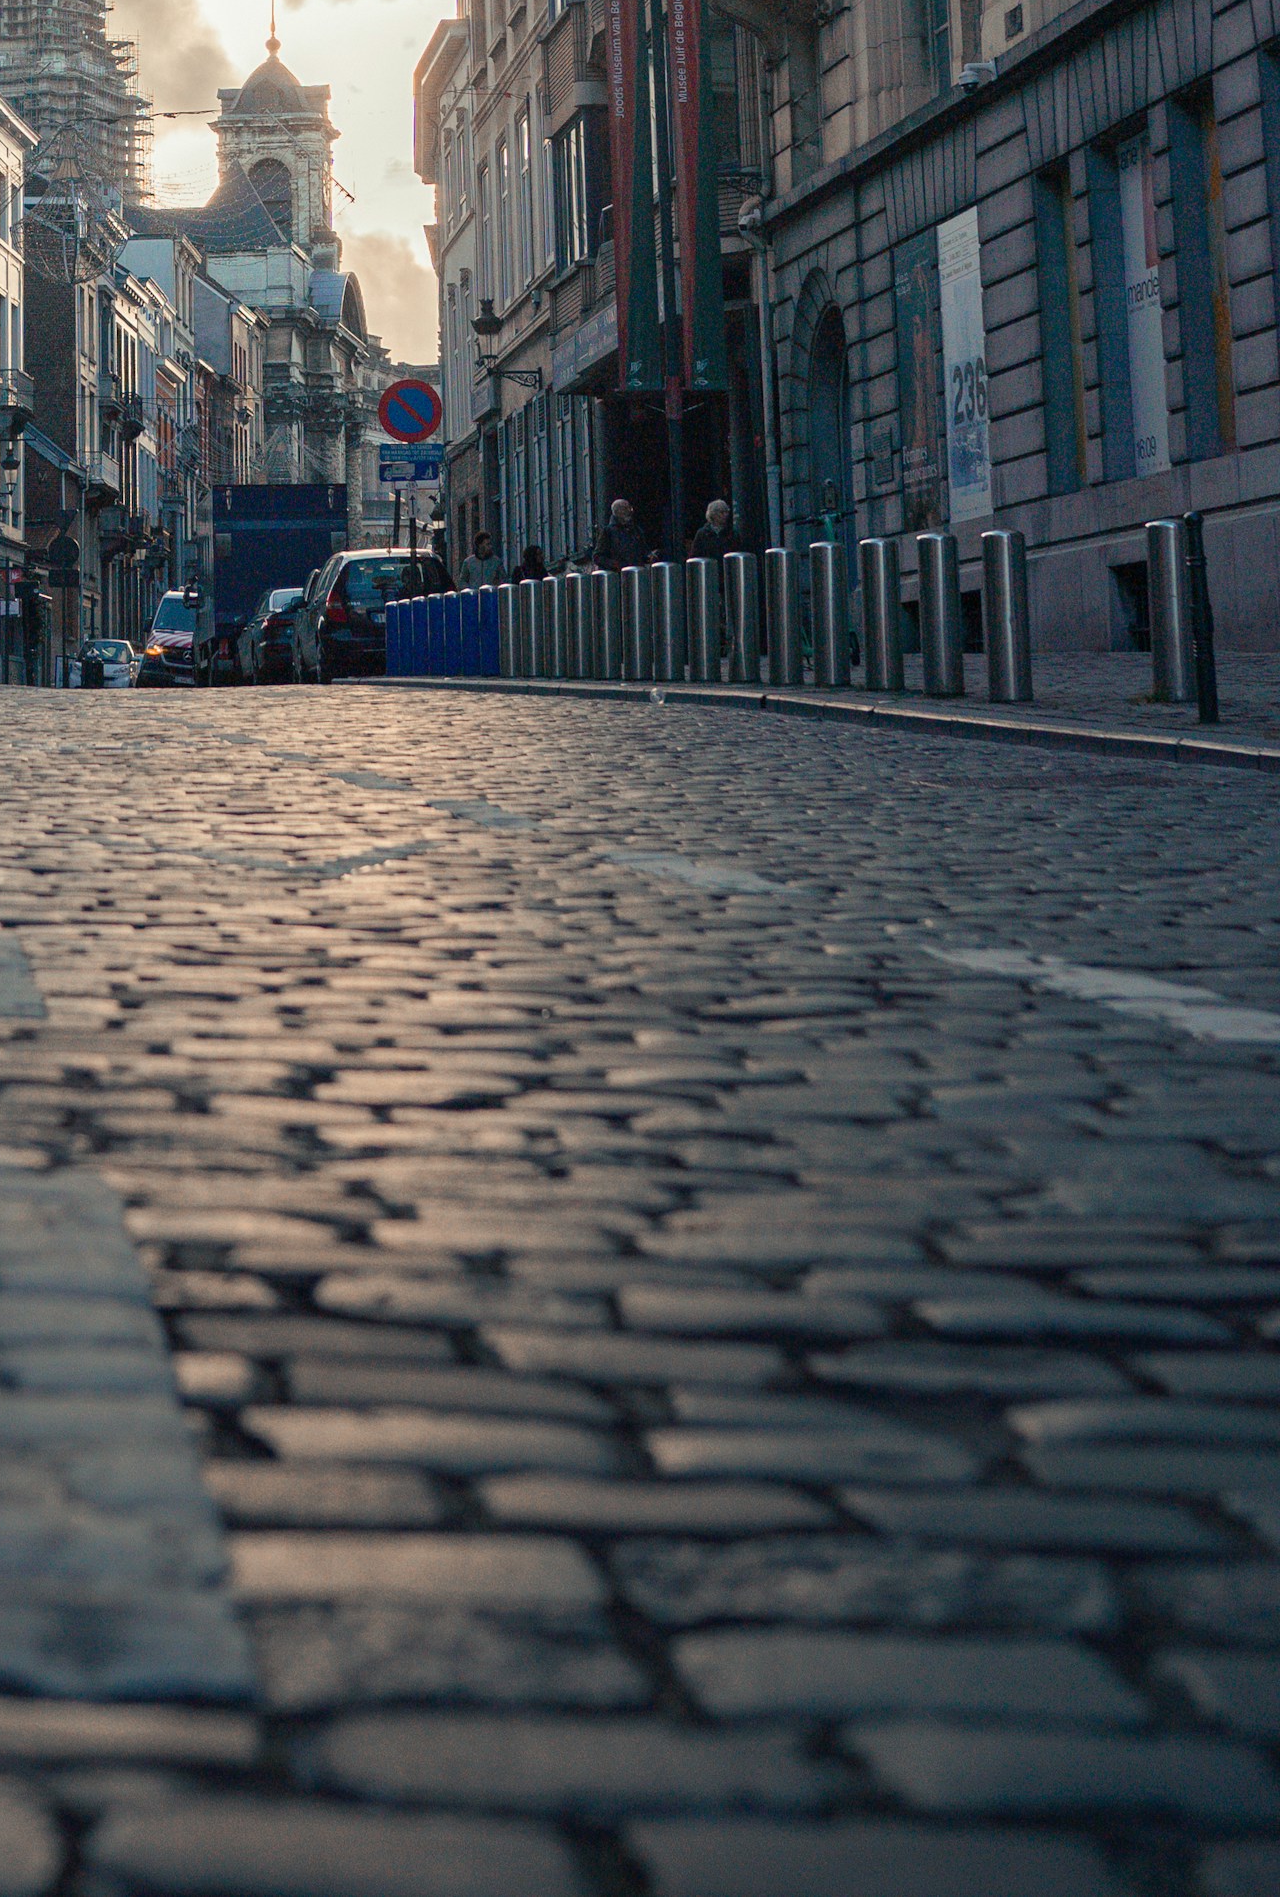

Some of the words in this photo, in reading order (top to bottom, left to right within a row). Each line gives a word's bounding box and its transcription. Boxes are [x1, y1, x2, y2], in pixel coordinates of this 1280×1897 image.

[611, 19, 621, 37] van
[675, 29, 685, 44] de
[612, 39, 624, 84] Museum
[675, 45, 687, 66] Juif
[614, 85, 625, 118] Joods
[676, 69, 688, 103] Musée
[952, 357, 988, 425] 236
